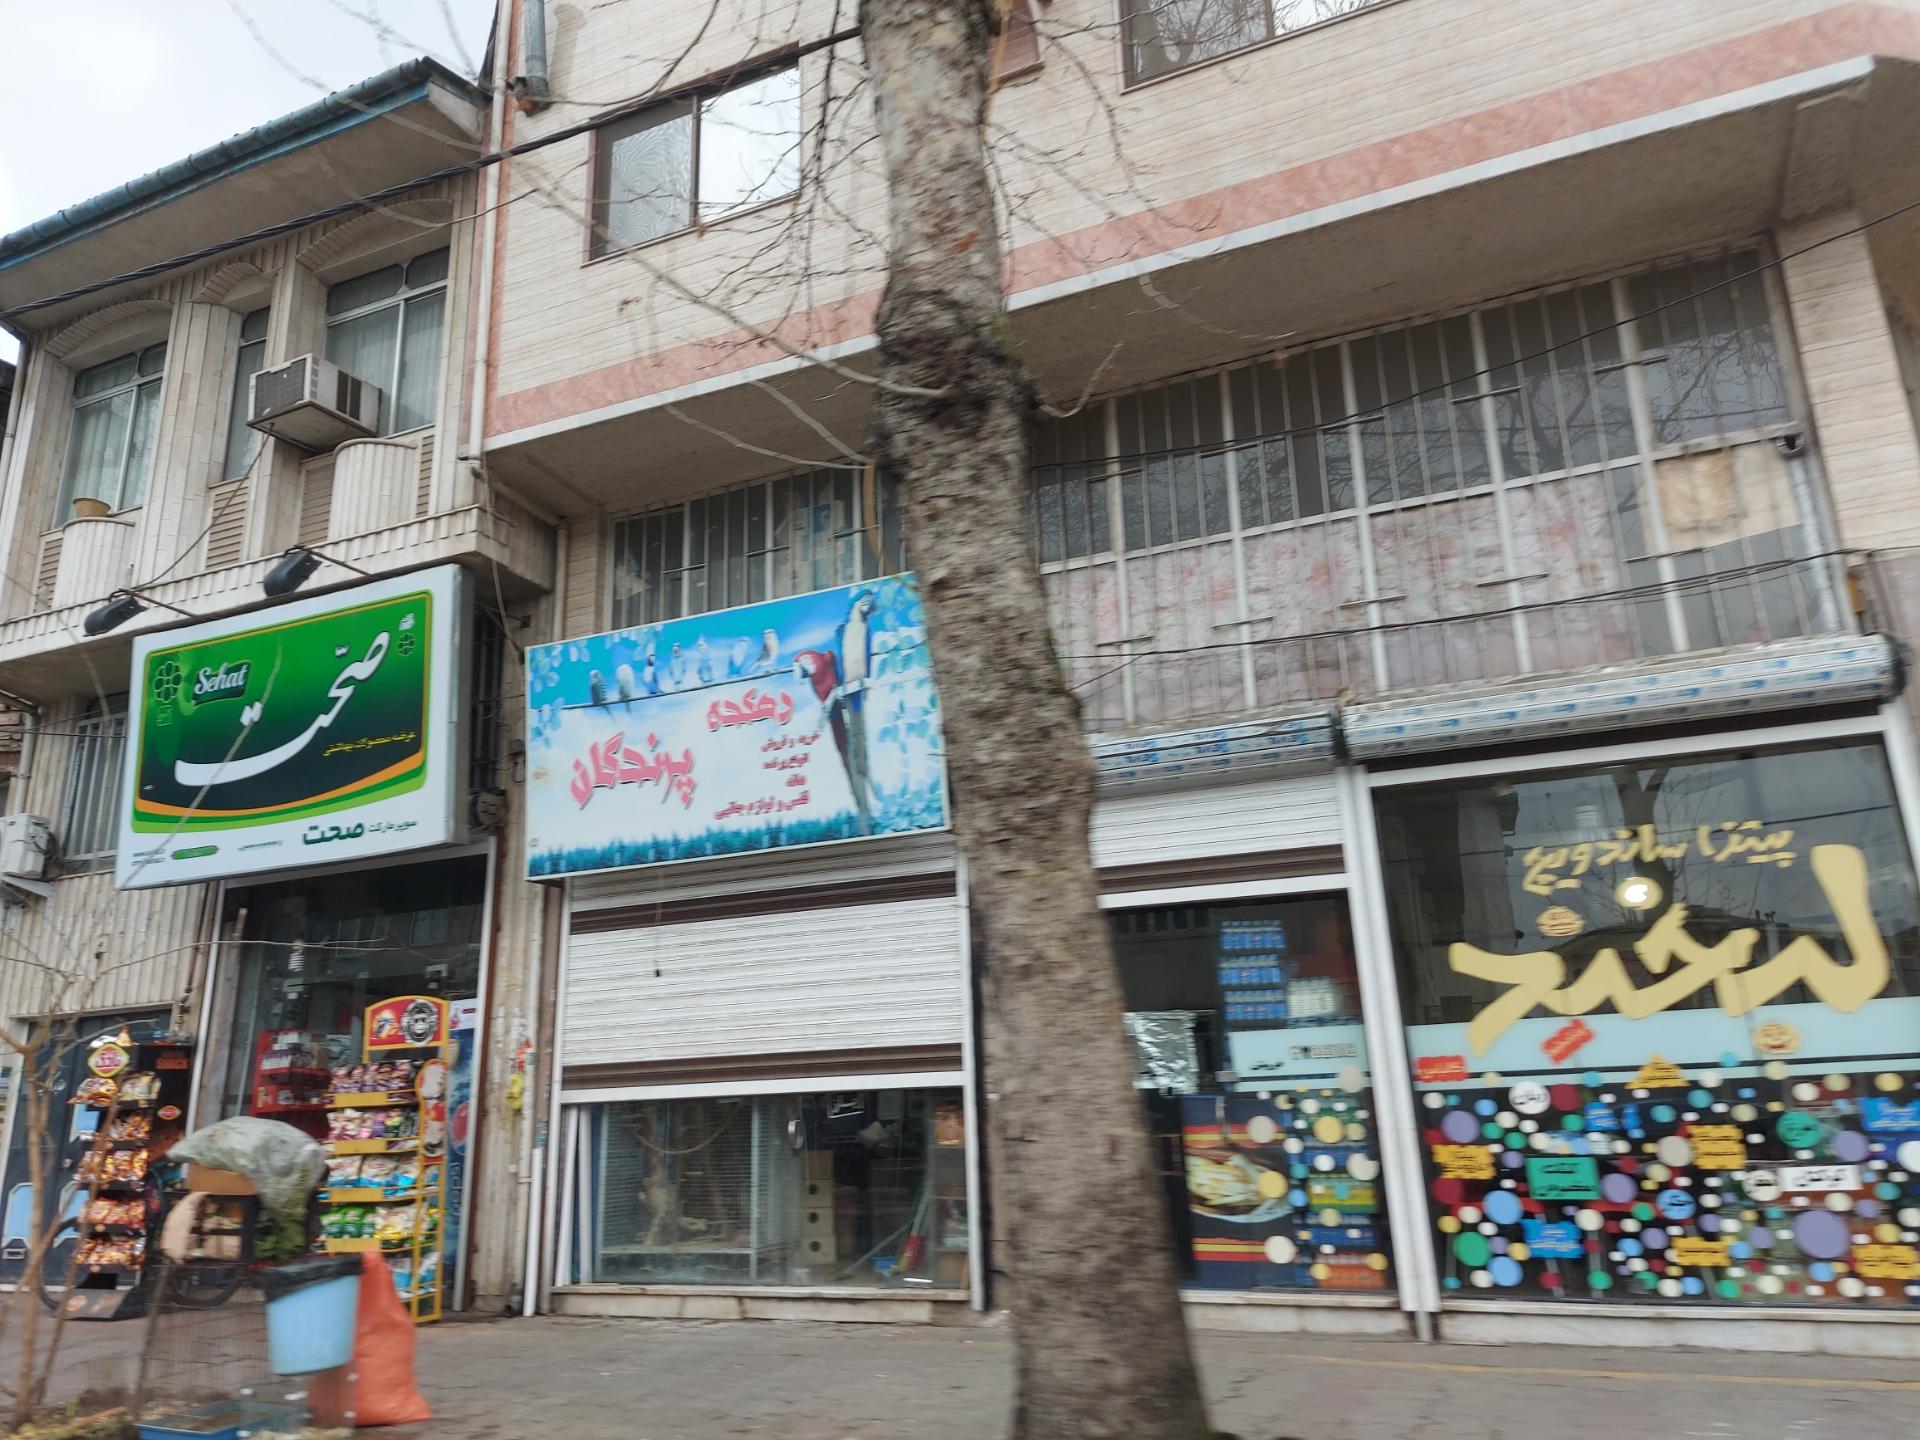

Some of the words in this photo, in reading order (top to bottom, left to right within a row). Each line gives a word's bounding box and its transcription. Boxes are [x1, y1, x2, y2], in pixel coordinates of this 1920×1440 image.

[194, 662, 248, 695] Sehat
[569, 732, 697, 809] پرندگان
[302, 821, 364, 846] صحت
[1697, 820, 1797, 869] پیتزا
[1521, 824, 1690, 896] ساندویچ
